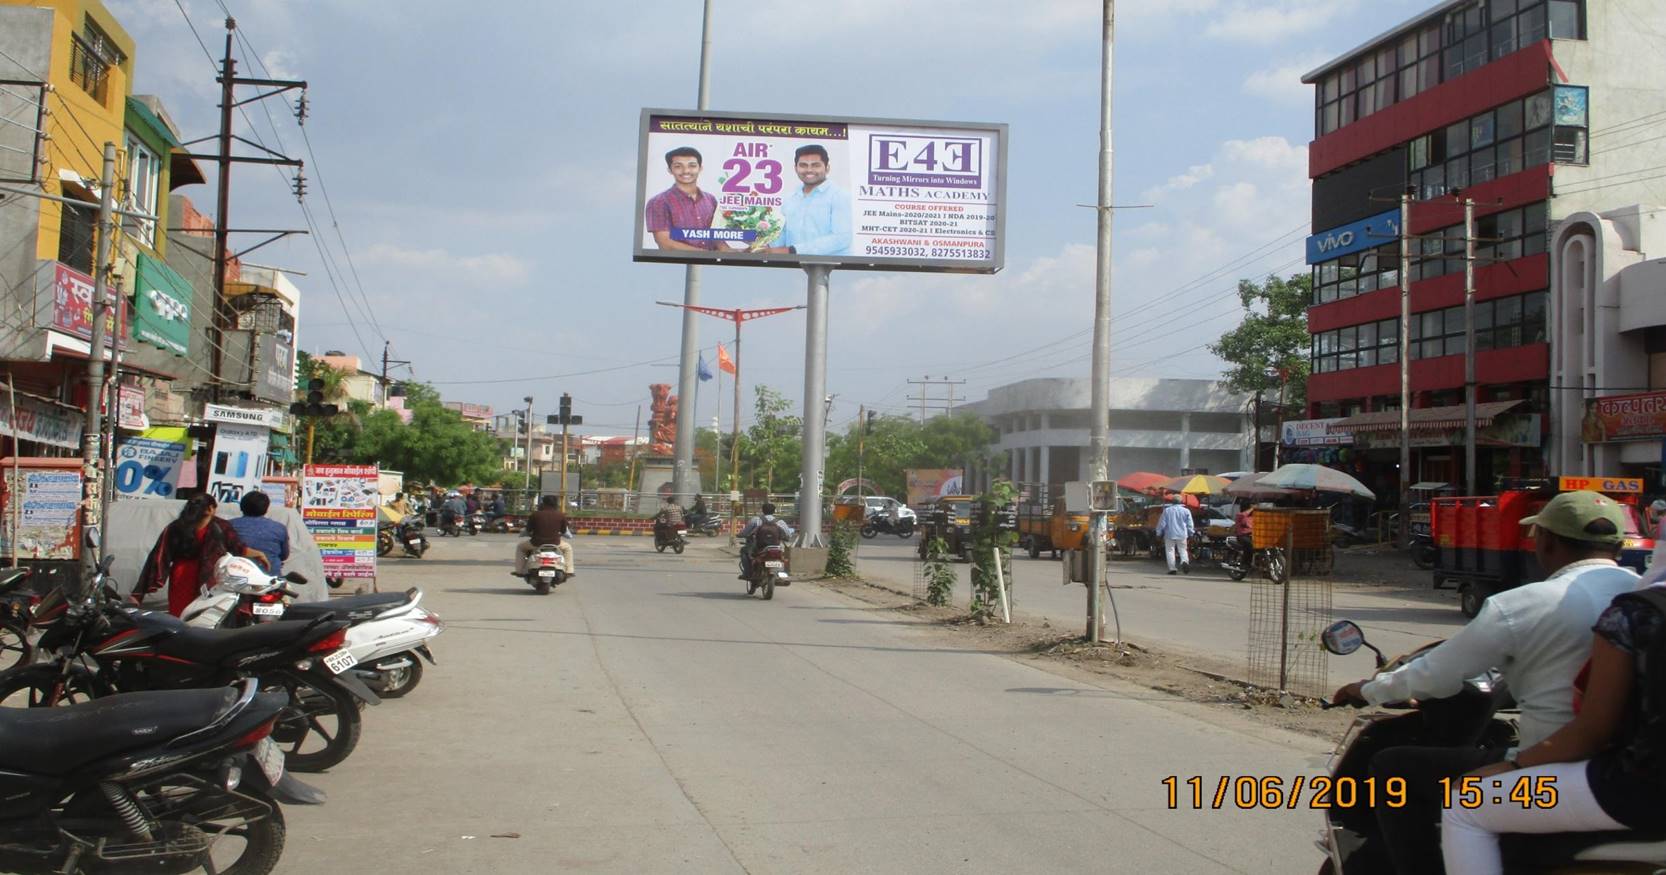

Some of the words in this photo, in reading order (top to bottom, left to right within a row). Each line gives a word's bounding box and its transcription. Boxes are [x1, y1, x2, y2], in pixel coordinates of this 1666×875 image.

[716, 120, 755, 133] यशाची
[758, 122, 791, 135] परंपरा
[722, 158, 783, 194] 23
[873, 174, 901, 183] Turning
[902, 175, 929, 183] Mirrors
[946, 177, 977, 185] Windows
[859, 186, 920, 198] MATHS
[925, 190, 991, 200] ACADEMY
[720, 196, 740, 204] JEE
[745, 197, 782, 206] MAINS
[682, 229, 710, 238] YASH
[714, 230, 744, 240] MORE
[861, 225, 898, 233] MHT-CET
[871, 238, 921, 246] AKASHWANI
[933, 239, 985, 247] OSMANPURA
[865, 245, 928, 257] 9545933032,
[931, 248, 991, 259] 8275513832
[213, 409, 263, 421] SAMSUNG
[140, 448, 179, 458] BAJAJ
[139, 454, 178, 464] FINSERV
[115, 460, 173, 497] 0%
[1565, 479, 1589, 490] HP
[1602, 480, 1639, 490] GAS
[330, 655, 354, 672] 6107
